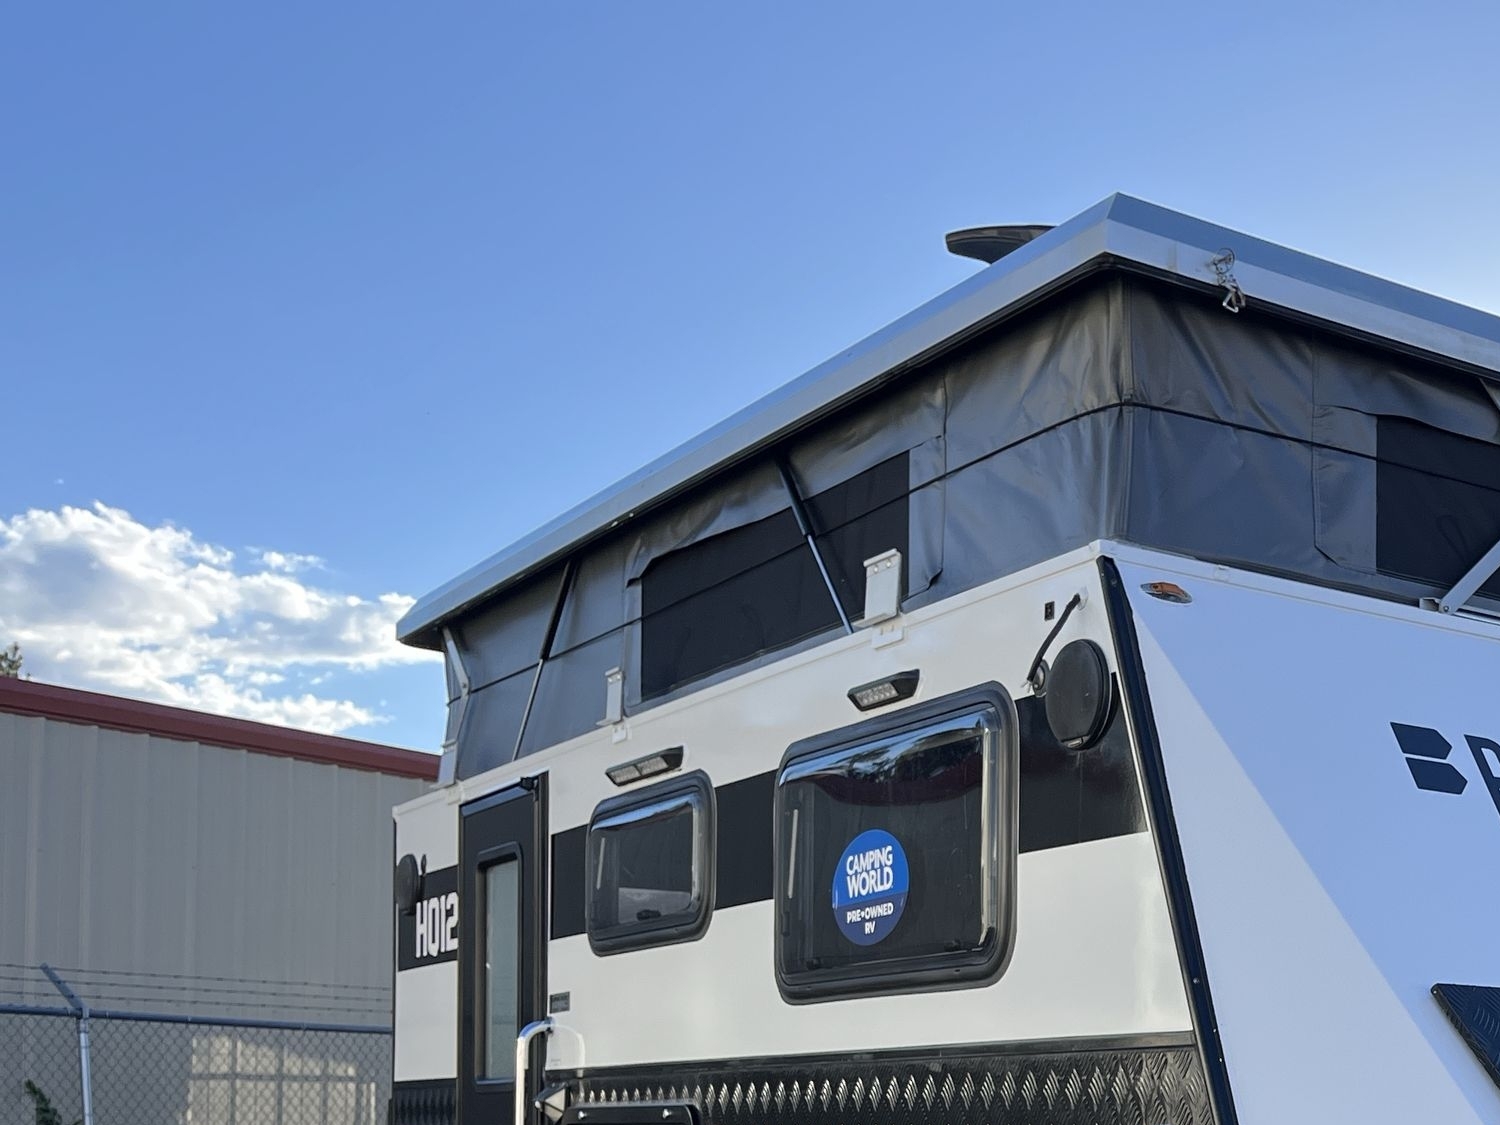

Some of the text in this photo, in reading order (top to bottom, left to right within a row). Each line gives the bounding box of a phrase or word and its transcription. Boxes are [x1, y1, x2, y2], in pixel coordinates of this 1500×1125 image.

[846, 845, 893, 875] CAMPING
[846, 866, 894, 899] WORLD
[415, 891, 459, 958] HQ12
[864, 920, 876, 934] RV
